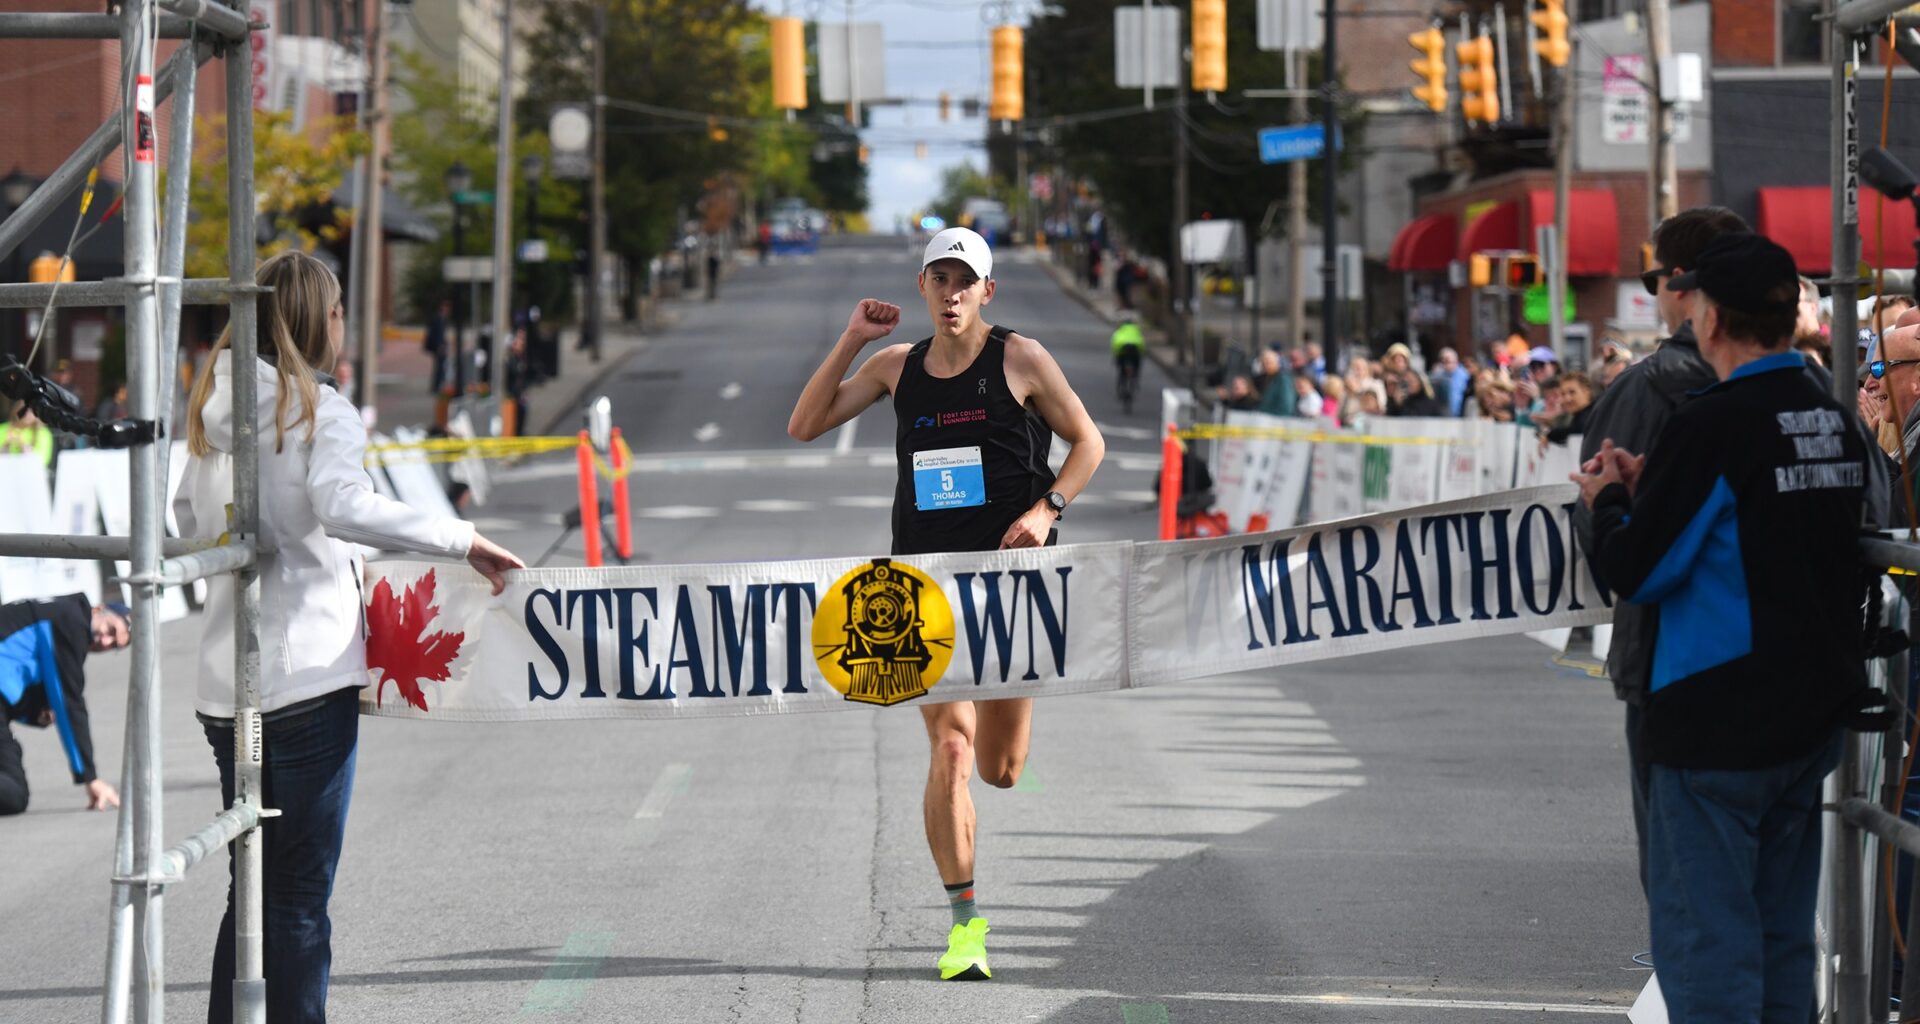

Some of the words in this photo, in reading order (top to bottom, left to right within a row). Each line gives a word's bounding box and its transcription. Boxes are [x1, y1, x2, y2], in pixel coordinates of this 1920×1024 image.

[960, 409, 986, 417] COLLINS
[940, 469, 954, 492] 5
[931, 490, 967, 501] THOMAS
